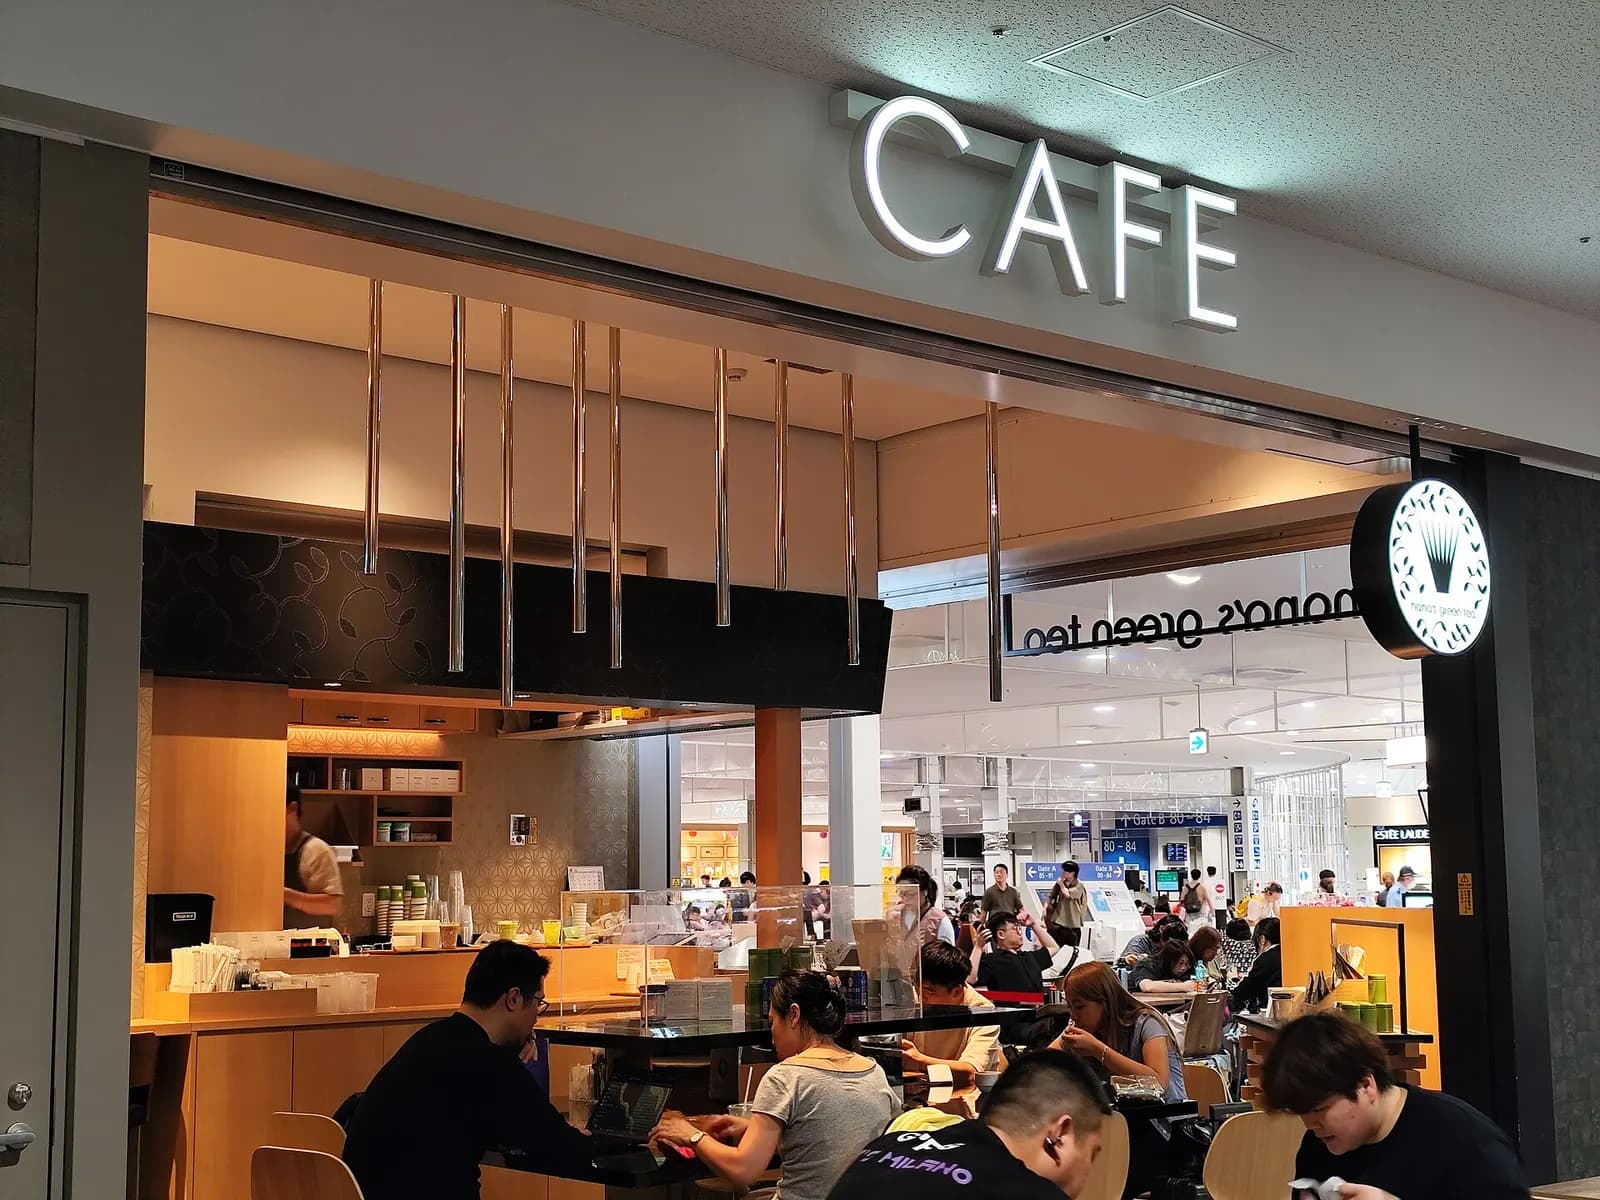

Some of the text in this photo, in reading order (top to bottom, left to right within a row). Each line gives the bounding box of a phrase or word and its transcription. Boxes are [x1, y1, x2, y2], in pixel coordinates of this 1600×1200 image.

[861, 95, 1239, 331] CAFE
[1439, 606, 1462, 617] green
[1463, 609, 1476, 619] tea
[1133, 813, 1156, 826] Gate
[1159, 813, 1165, 825] B
[1400, 828, 1431, 839] LAUDE
[1103, 840, 1115, 852] 80
[1125, 841, 1136, 853] 84
